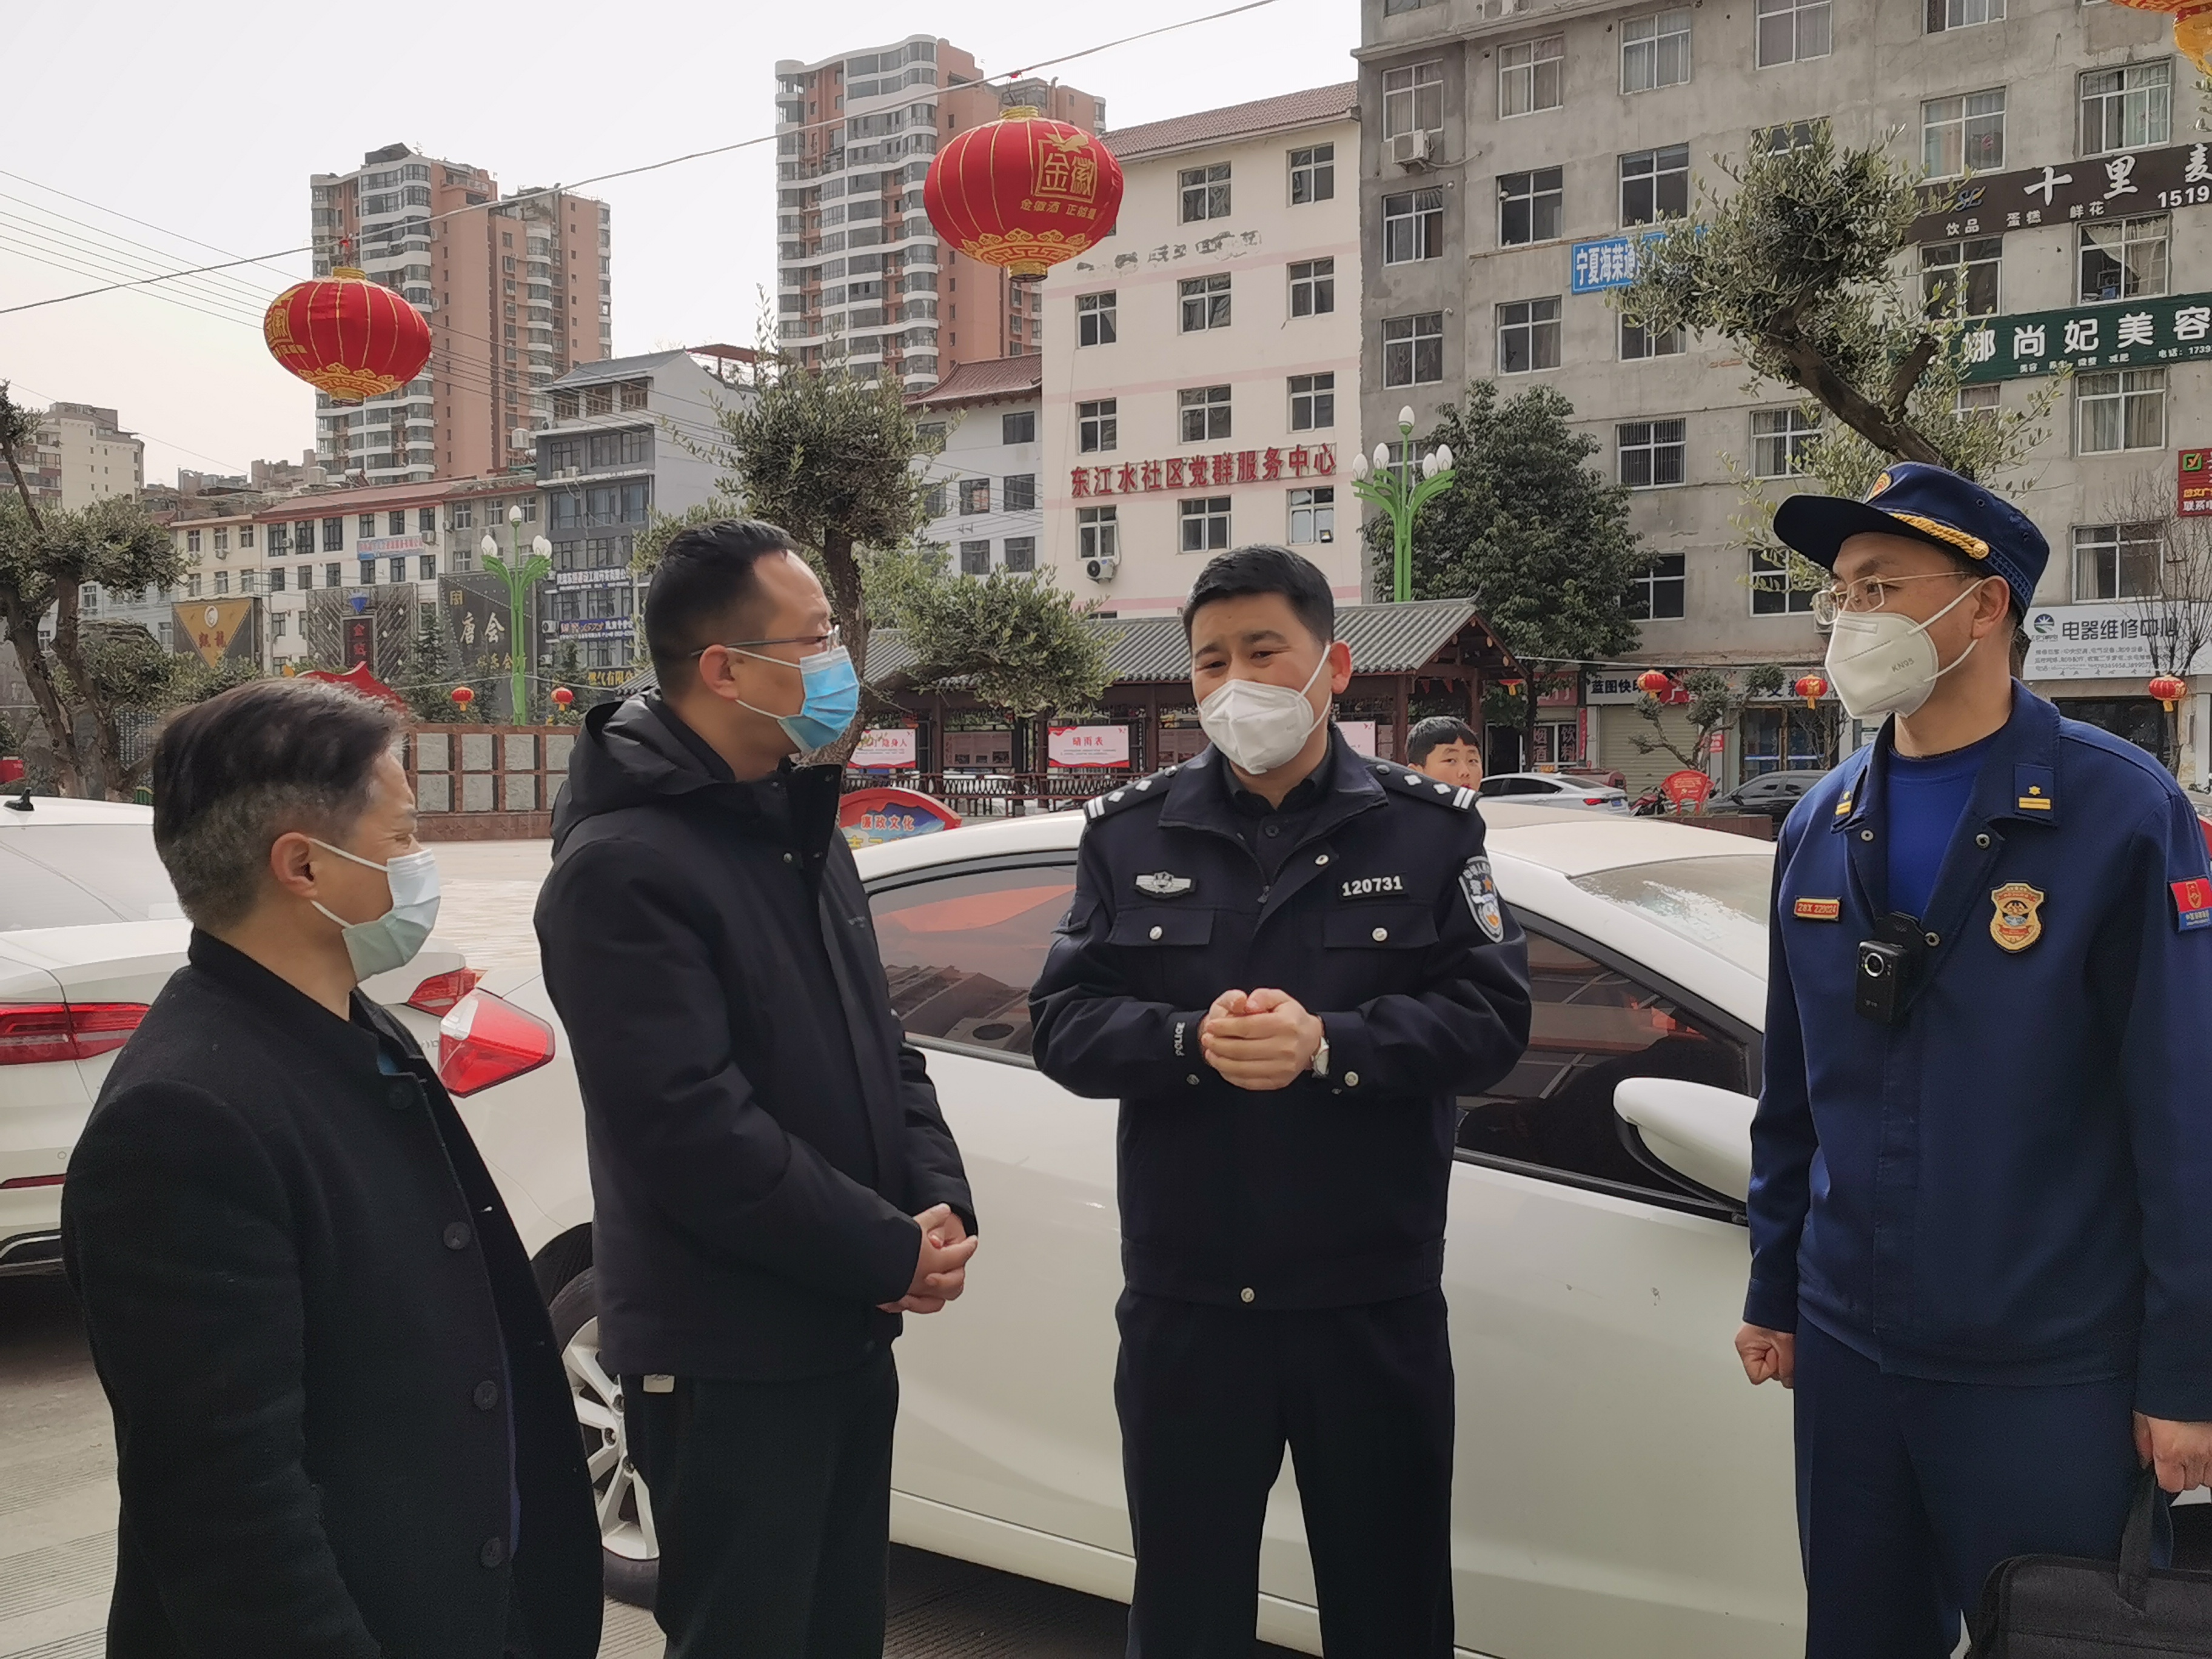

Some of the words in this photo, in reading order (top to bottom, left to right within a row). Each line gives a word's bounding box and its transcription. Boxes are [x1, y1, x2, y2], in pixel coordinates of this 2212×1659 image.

[1044, 153, 1094, 196] 金徽
[2023, 143, 2212, 206] 十里麦
[2157, 185, 2210, 208] 1519
[1946, 218, 1979, 236] 饮品
[2006, 210, 2042, 227] 蛋糕
[2070, 201, 2105, 219] 鲜花
[1070, 444, 1335, 497] 东江水社区党群服务中心
[2062, 617, 2177, 641] 电器维修中心
[1342, 876, 1403, 897] 120731
[1174, 1021, 1185, 1056] POLICE
